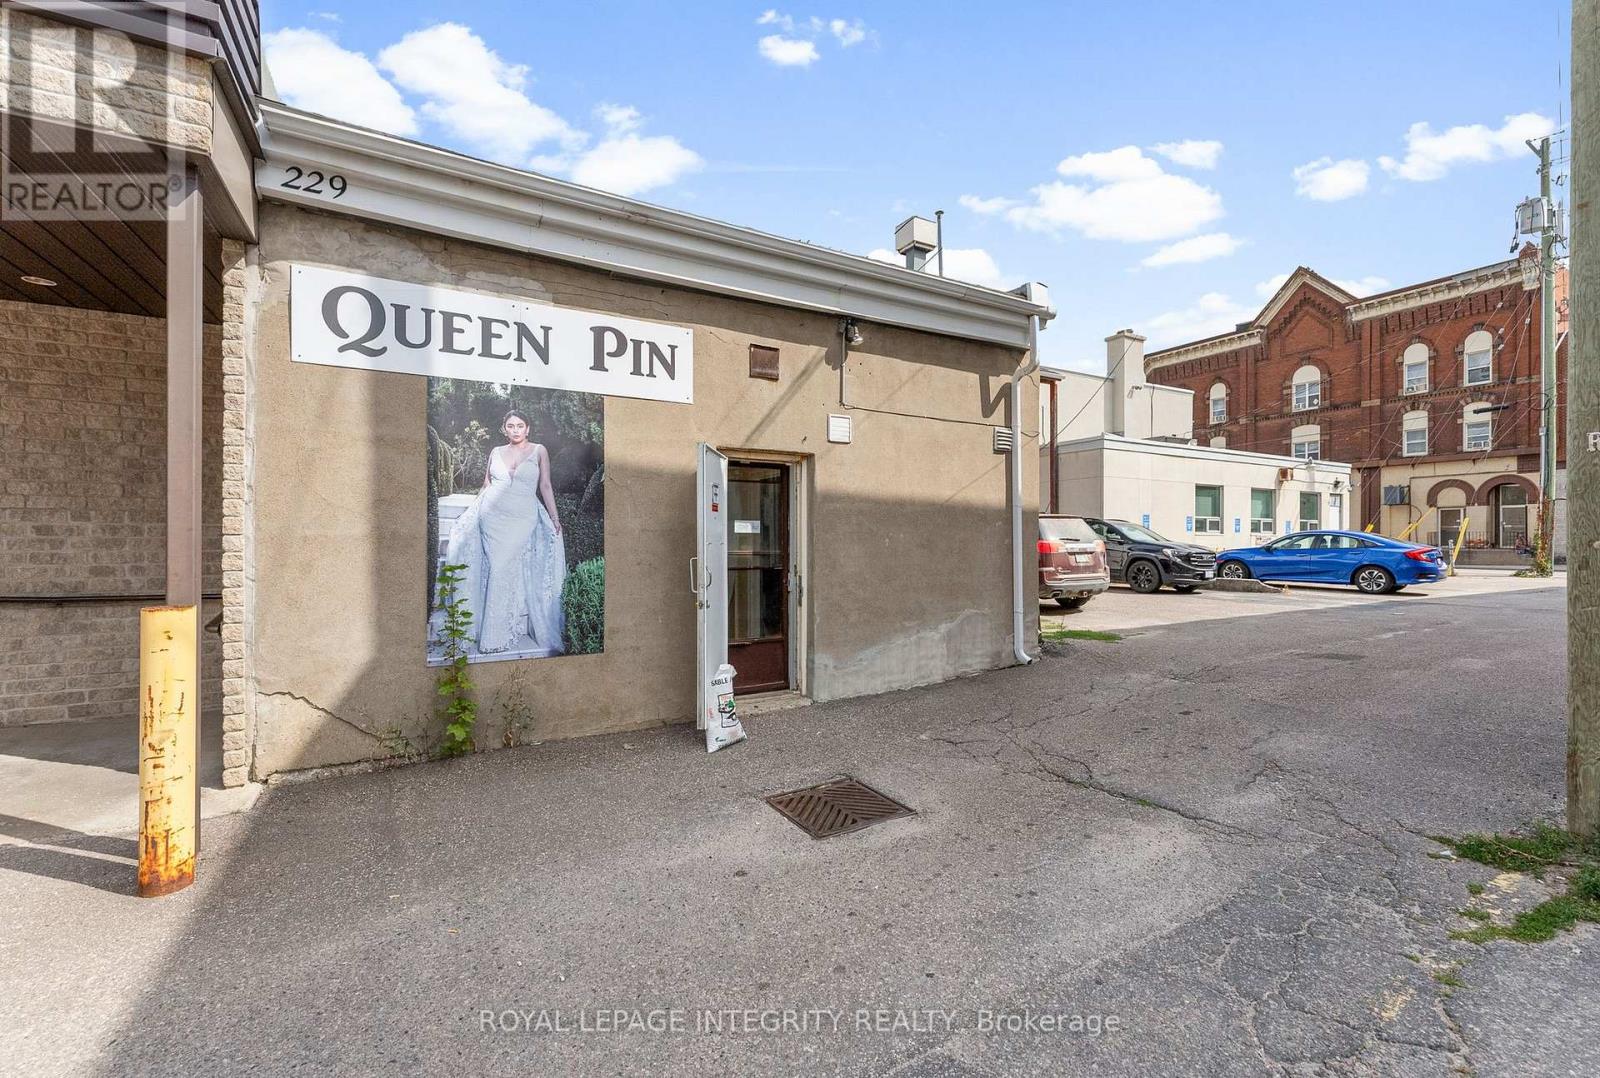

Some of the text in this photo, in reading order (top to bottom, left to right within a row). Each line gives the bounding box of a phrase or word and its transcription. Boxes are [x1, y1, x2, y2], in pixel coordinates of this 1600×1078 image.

[281, 166, 348, 200] 229
[322, 285, 679, 381] QUEEN PIN
